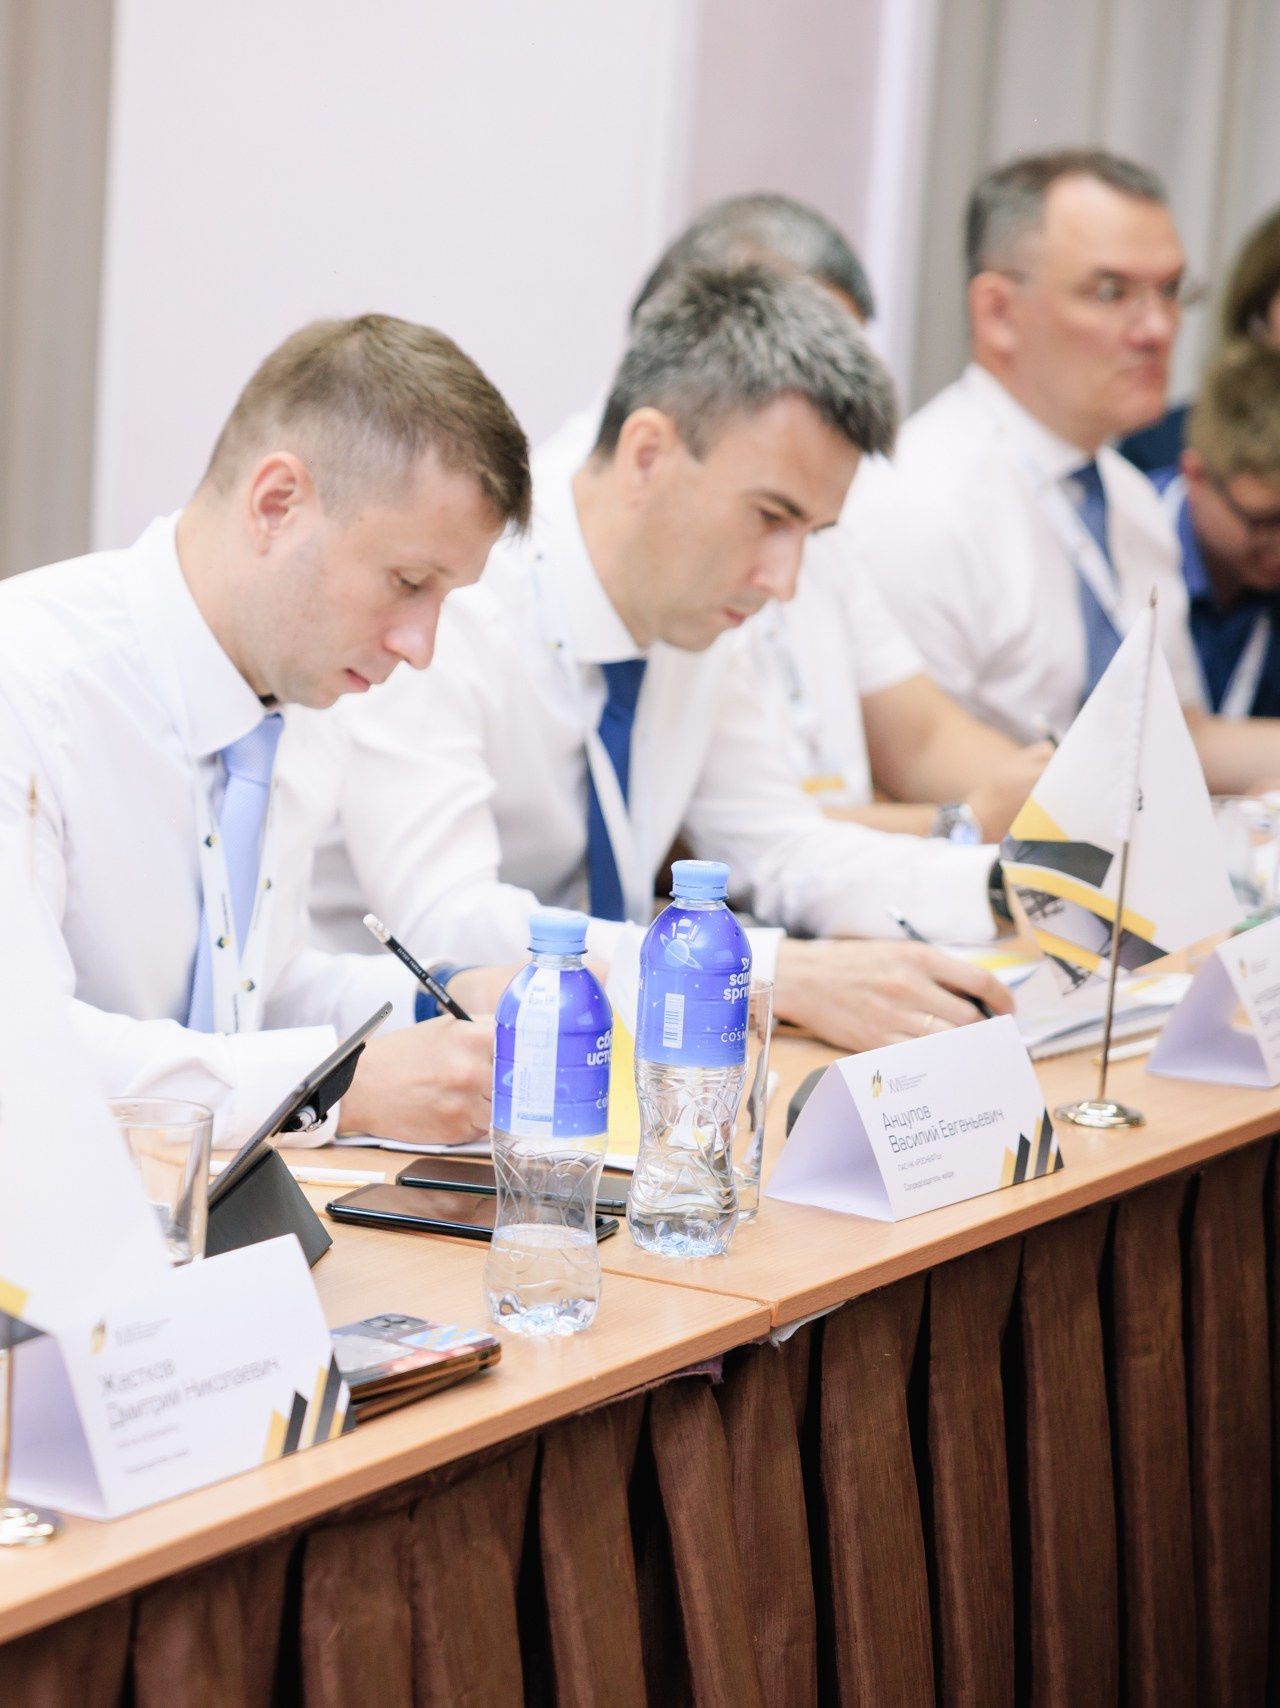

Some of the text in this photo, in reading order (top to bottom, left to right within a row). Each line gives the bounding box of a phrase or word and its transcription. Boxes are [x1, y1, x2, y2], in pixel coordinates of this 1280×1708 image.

[882, 1105, 932, 1131] Анцупов
[888, 1107, 1006, 1154] Василий Евгеньевич
